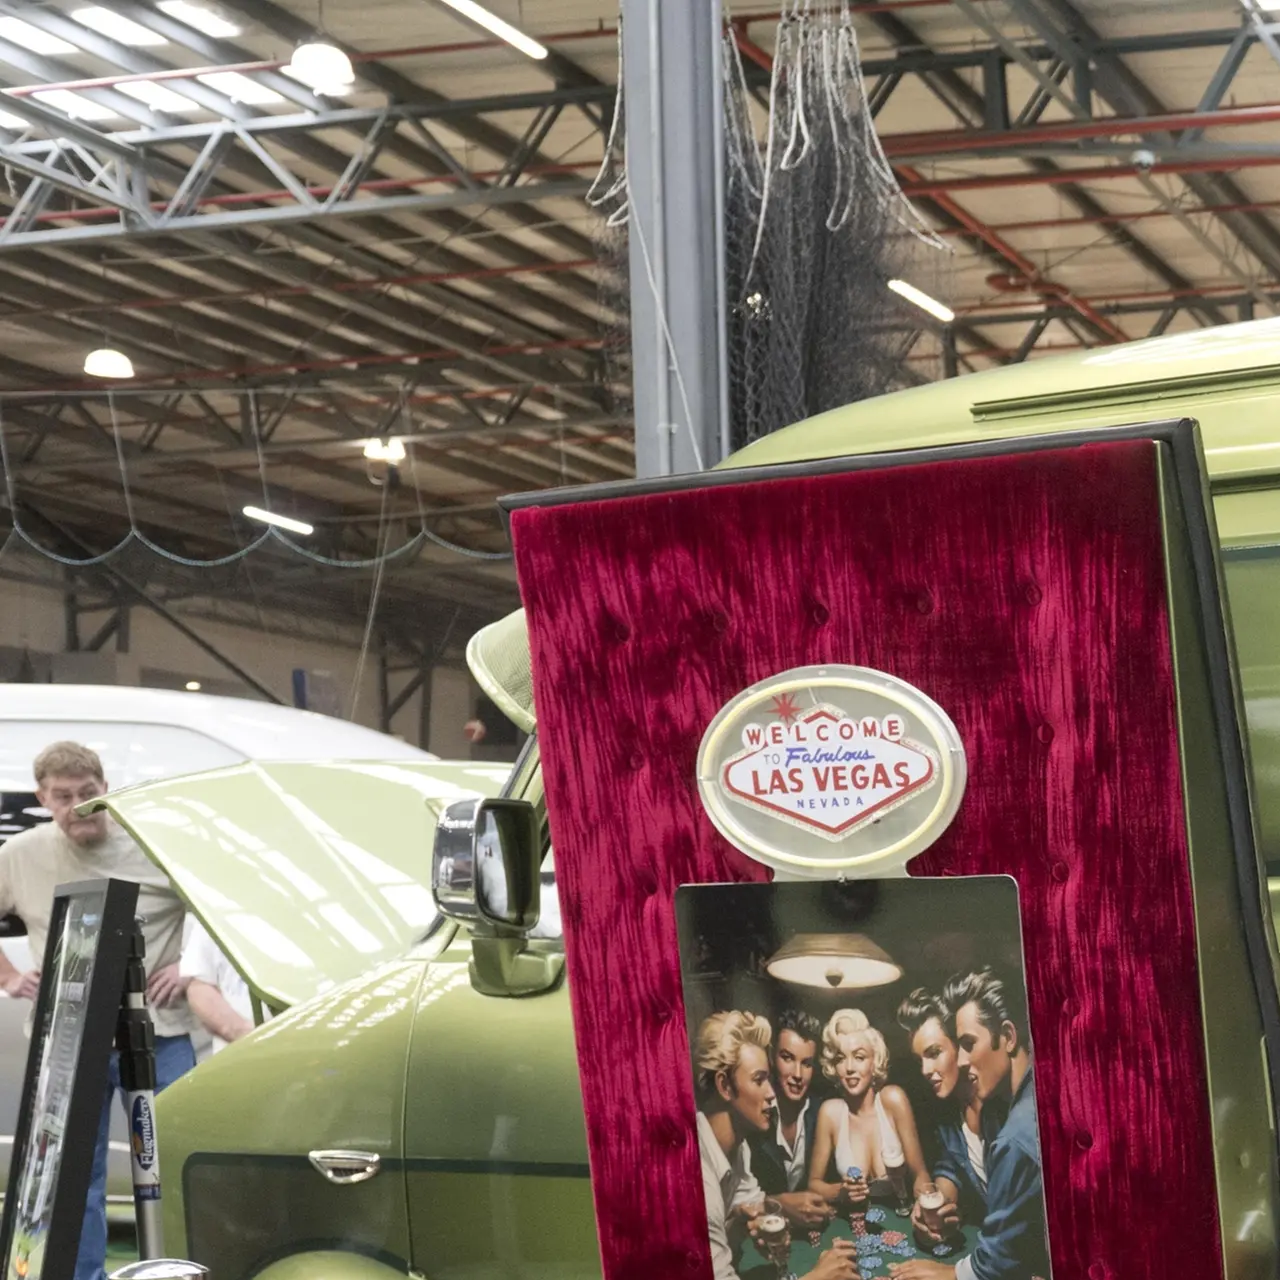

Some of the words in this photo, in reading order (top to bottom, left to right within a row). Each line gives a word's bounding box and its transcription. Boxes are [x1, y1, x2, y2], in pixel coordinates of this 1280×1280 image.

[746, 720, 900, 746] WELCOME
[764, 754, 780, 765] TO
[785, 746, 875, 768] Fabulous
[752, 767, 804, 795] LAS
[812, 762, 910, 791] VEGAS
[797, 796, 864, 809] NEVADA
[136, 1098, 156, 1165] Flagmakers
